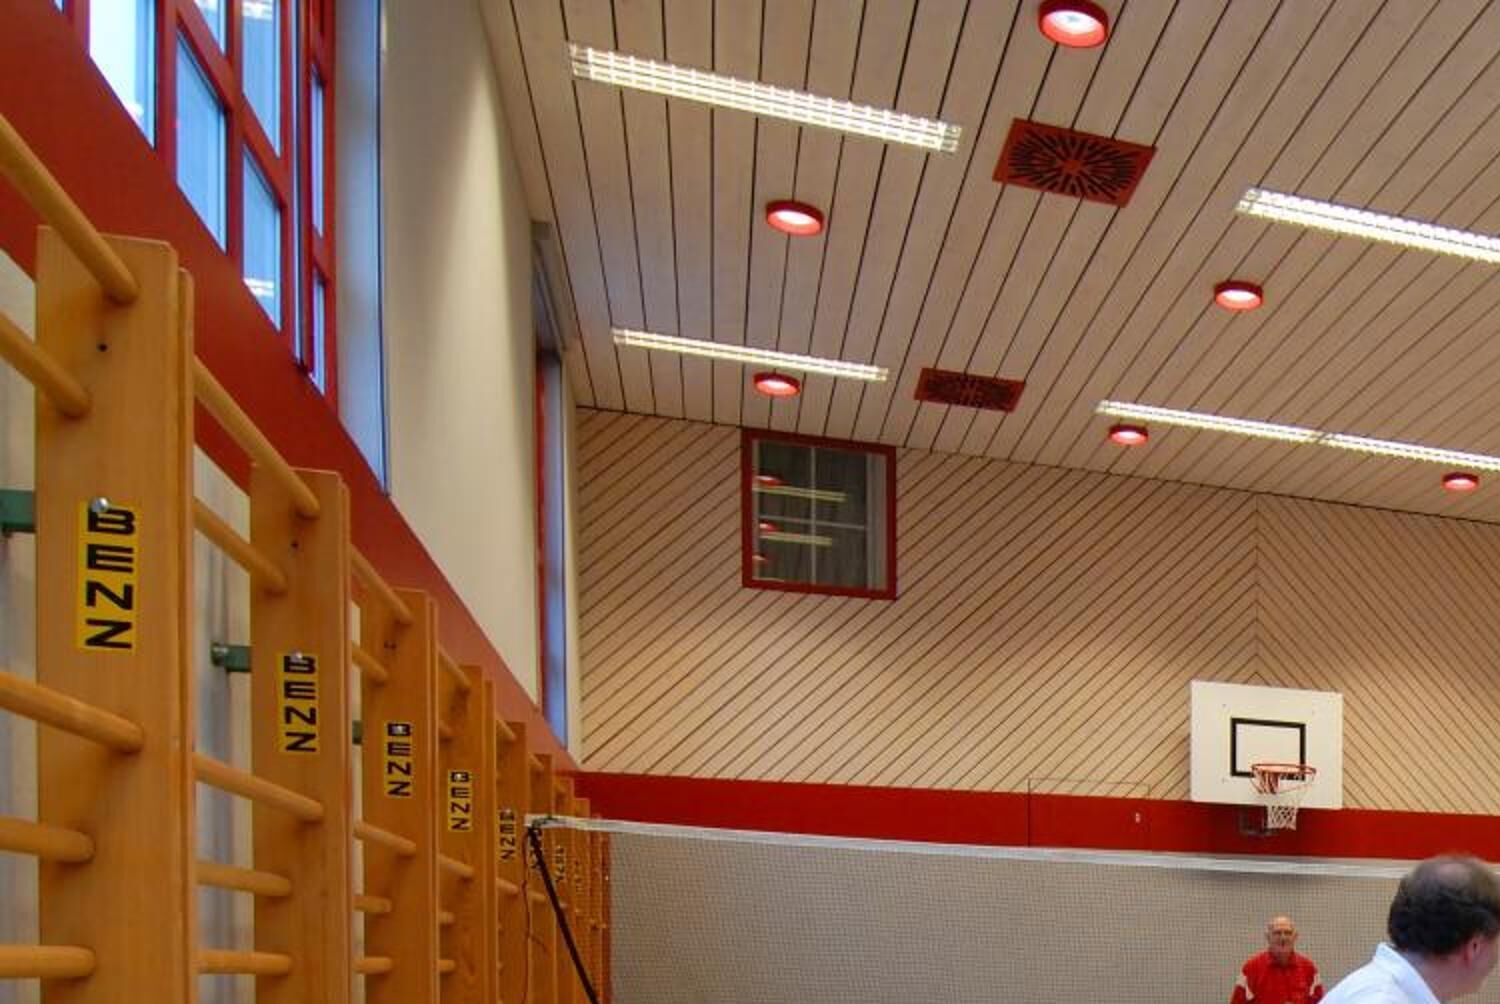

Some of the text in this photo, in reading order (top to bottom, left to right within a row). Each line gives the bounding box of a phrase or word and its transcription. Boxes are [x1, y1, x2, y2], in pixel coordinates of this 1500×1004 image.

[84, 506, 136, 649] BENZ
[283, 655, 317, 753] BENZ
[386, 723, 412, 797] BENZ
[450, 771, 471, 831] BENZ
